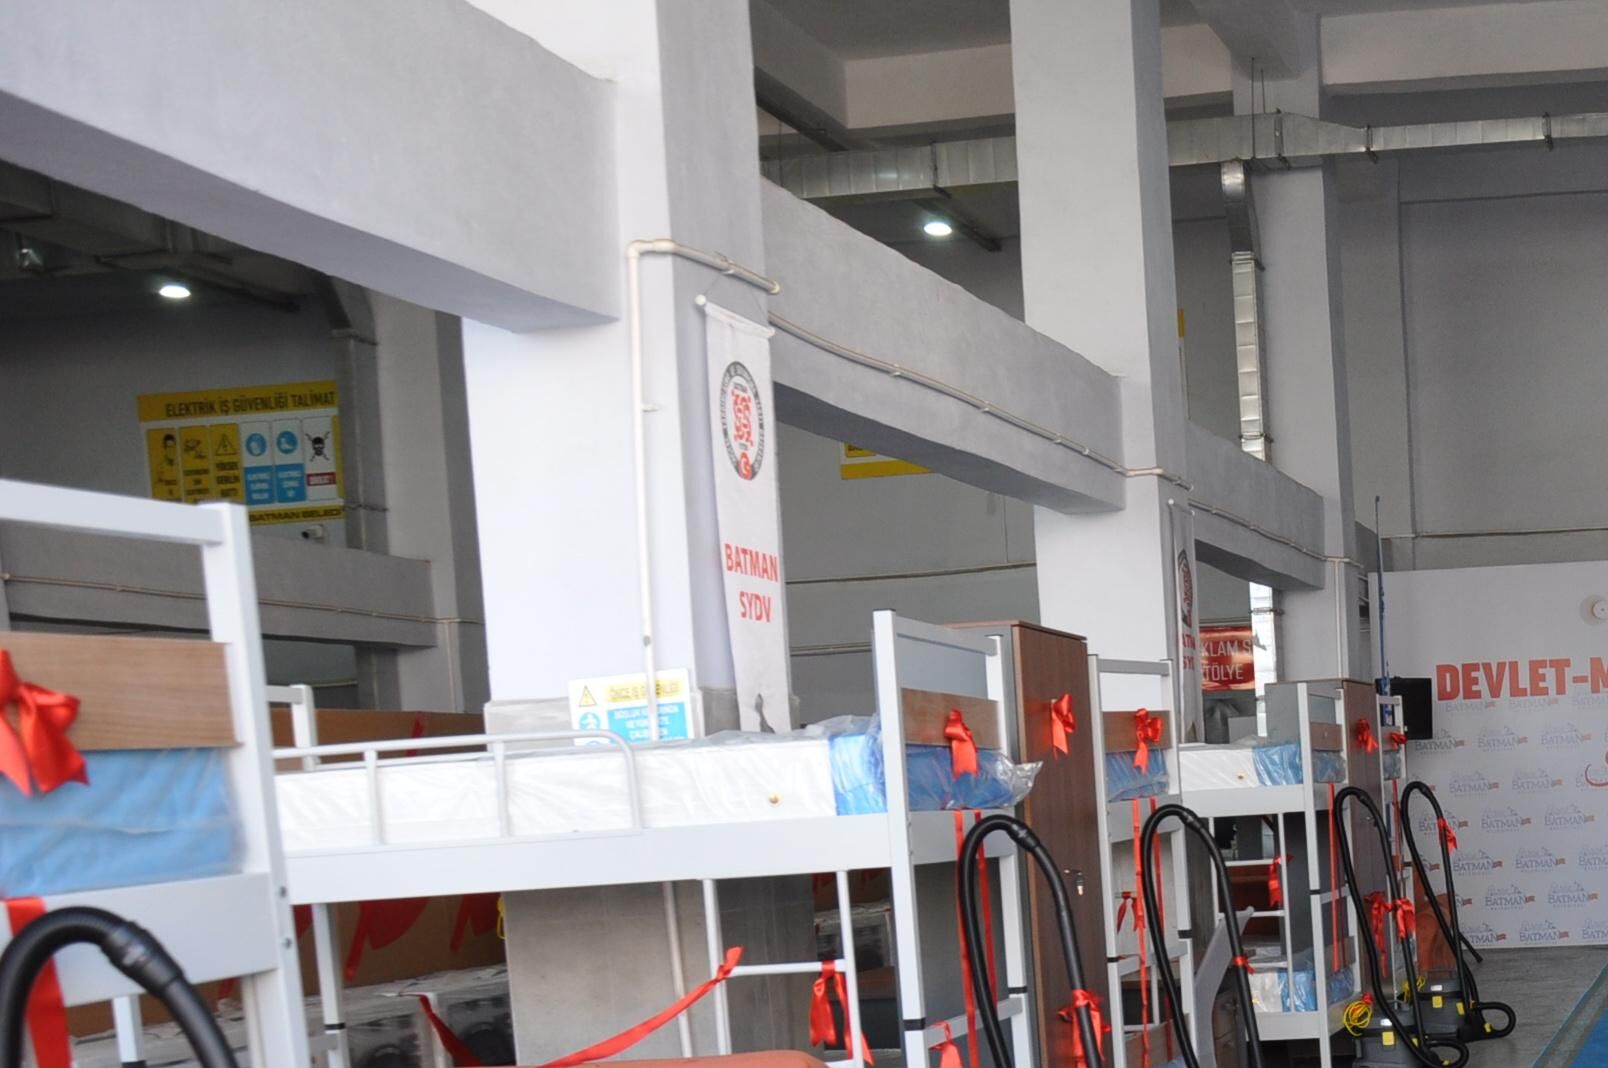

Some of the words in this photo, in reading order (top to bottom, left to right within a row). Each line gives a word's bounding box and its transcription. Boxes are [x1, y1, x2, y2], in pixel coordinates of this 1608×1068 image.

[724, 543, 778, 582] BATMAN
[739, 590, 771, 623] SYDV
[1201, 639, 1238, 656] KLAM
